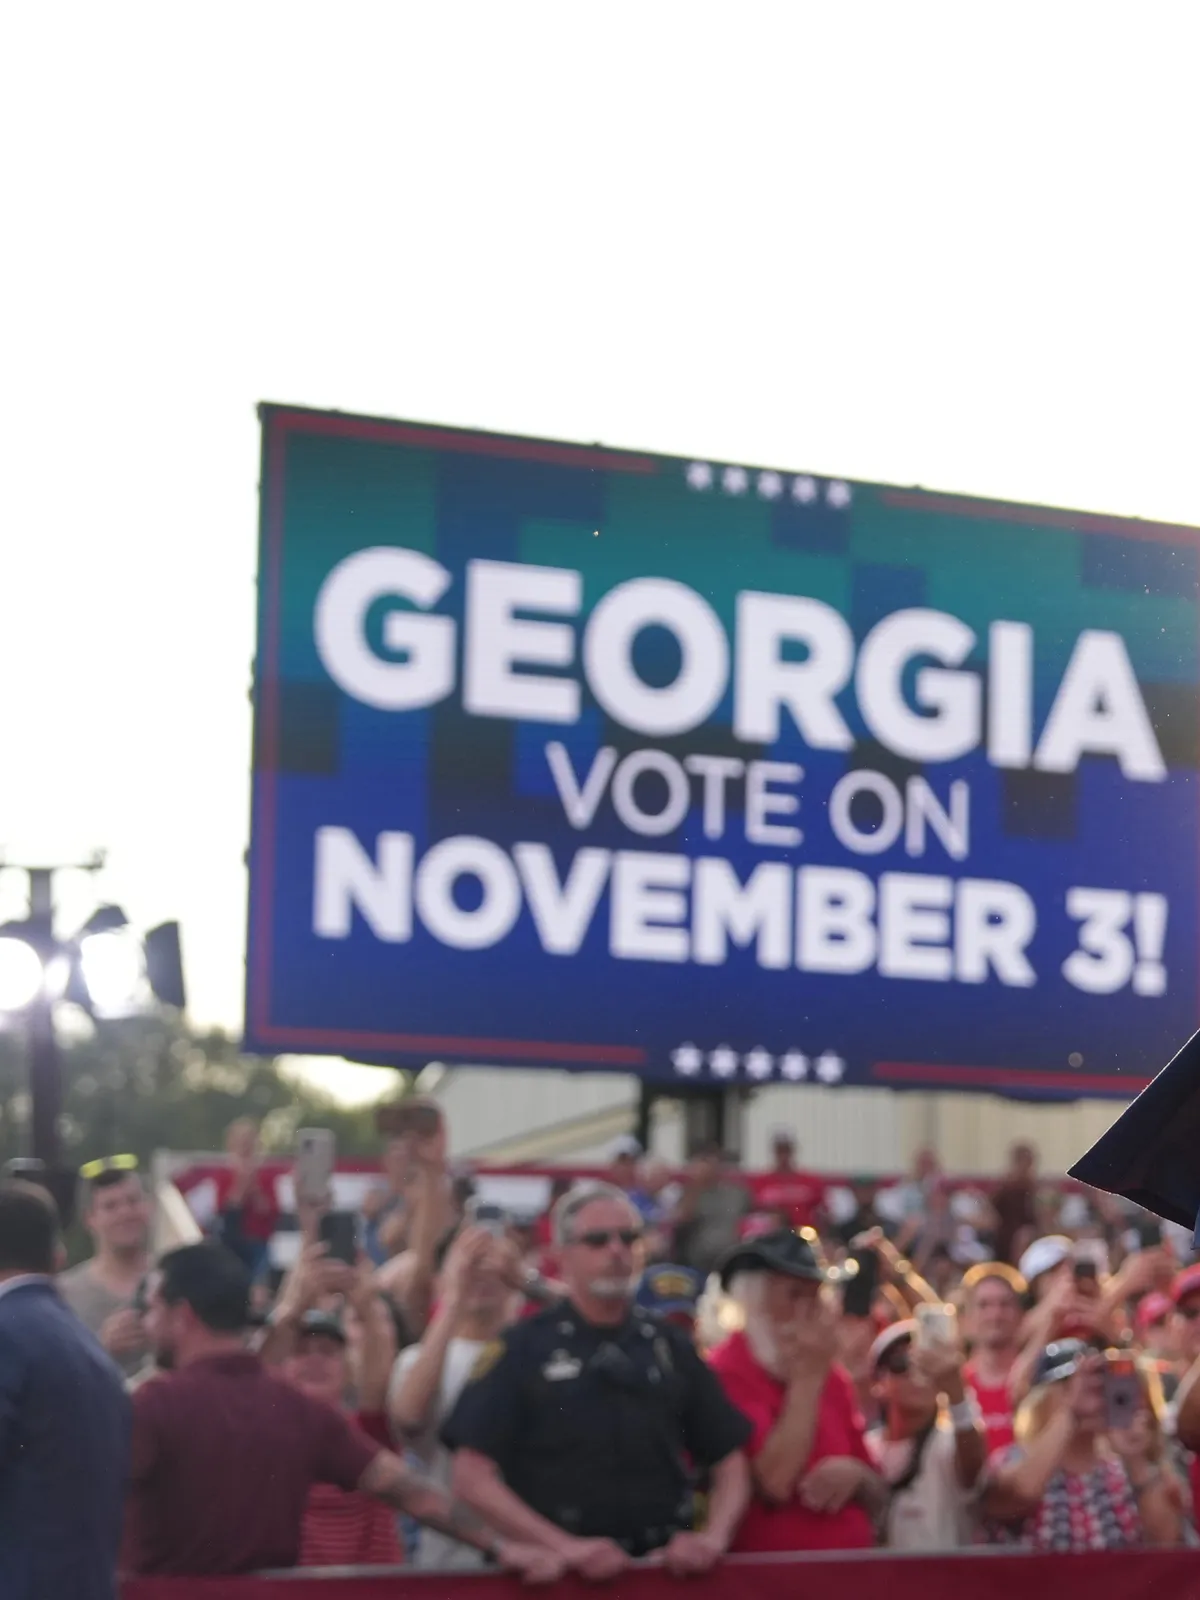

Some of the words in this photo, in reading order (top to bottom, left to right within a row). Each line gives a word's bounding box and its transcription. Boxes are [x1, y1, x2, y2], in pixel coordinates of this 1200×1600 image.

[314, 546, 1167, 782] GEORGIA
[547, 742, 802, 846] VOTE
[829, 769, 969, 859] ON
[314, 826, 1036, 987] NOVEMBER
[1062, 887, 1168, 997] 3!
